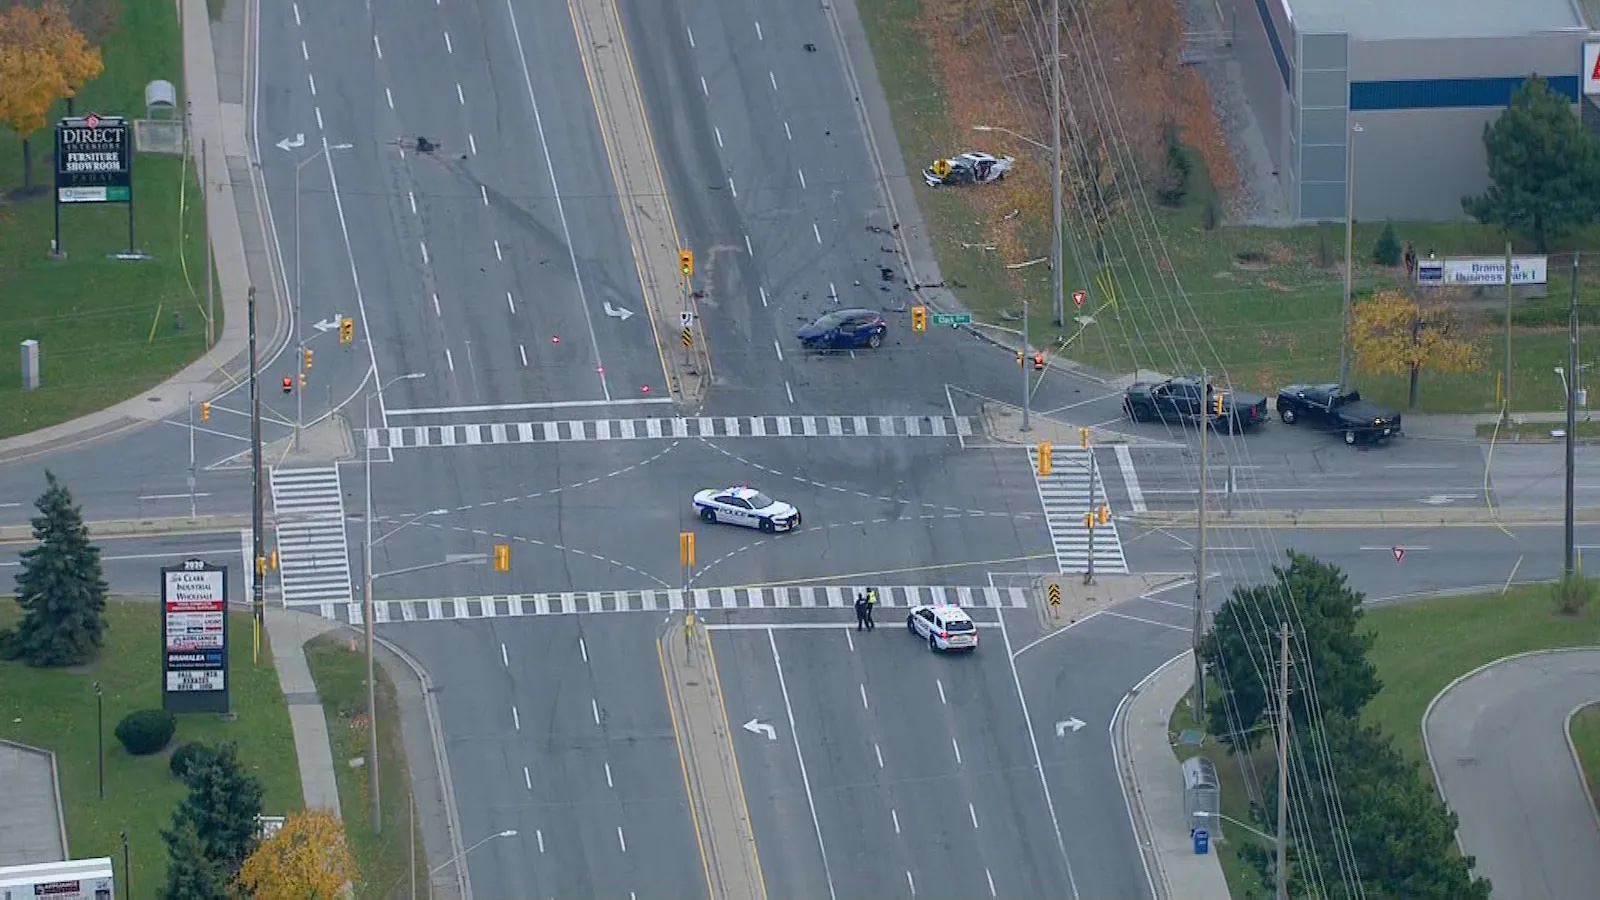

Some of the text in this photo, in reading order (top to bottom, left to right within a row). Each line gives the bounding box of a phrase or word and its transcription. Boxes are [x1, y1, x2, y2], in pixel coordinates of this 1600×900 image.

[63, 129, 124, 143] DIRECT
[67, 152, 119, 161] FURNITURE
[66, 161, 121, 171] SHOWROOM
[1472, 263, 1520, 272] Bramaa
[720, 507, 747, 517] POLICE
[176, 583, 211, 591] INDUSTRIAL
[176, 592, 213, 600] WHOLESALE
